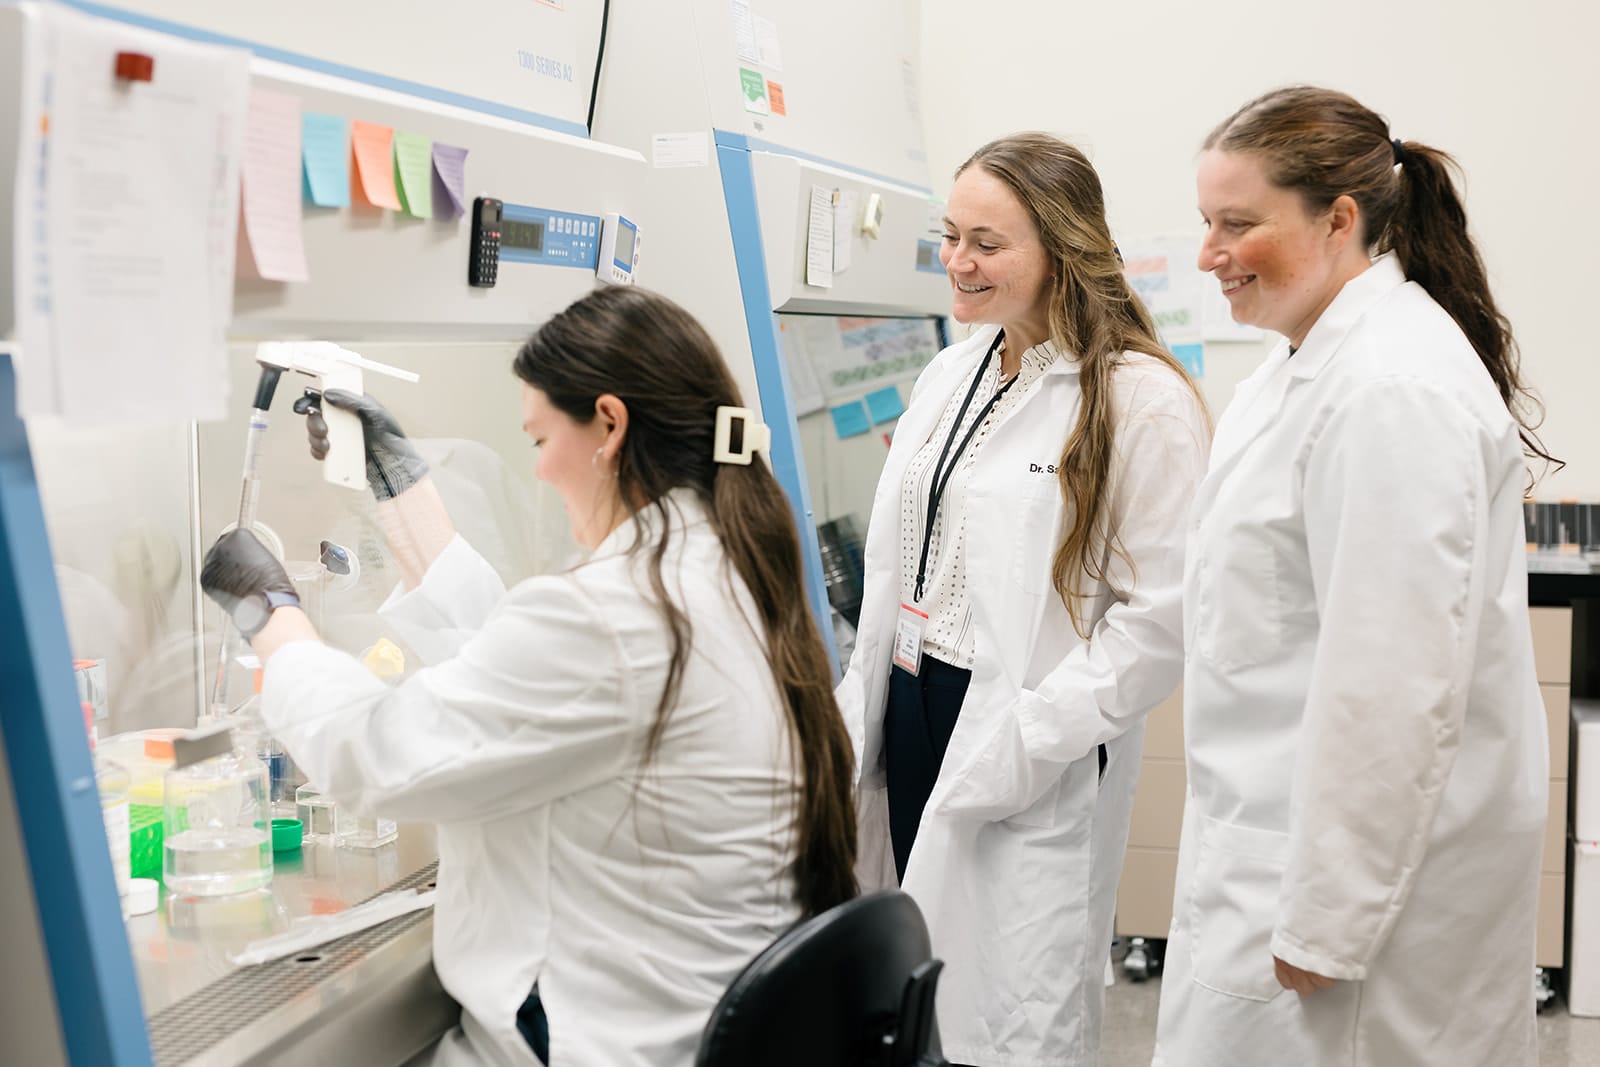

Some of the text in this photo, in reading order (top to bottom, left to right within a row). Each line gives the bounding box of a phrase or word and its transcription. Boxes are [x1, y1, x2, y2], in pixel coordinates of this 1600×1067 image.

[535, 56, 561, 79] SERIES
[563, 64, 573, 82] A2
[1029, 463, 1044, 473] Dr.
